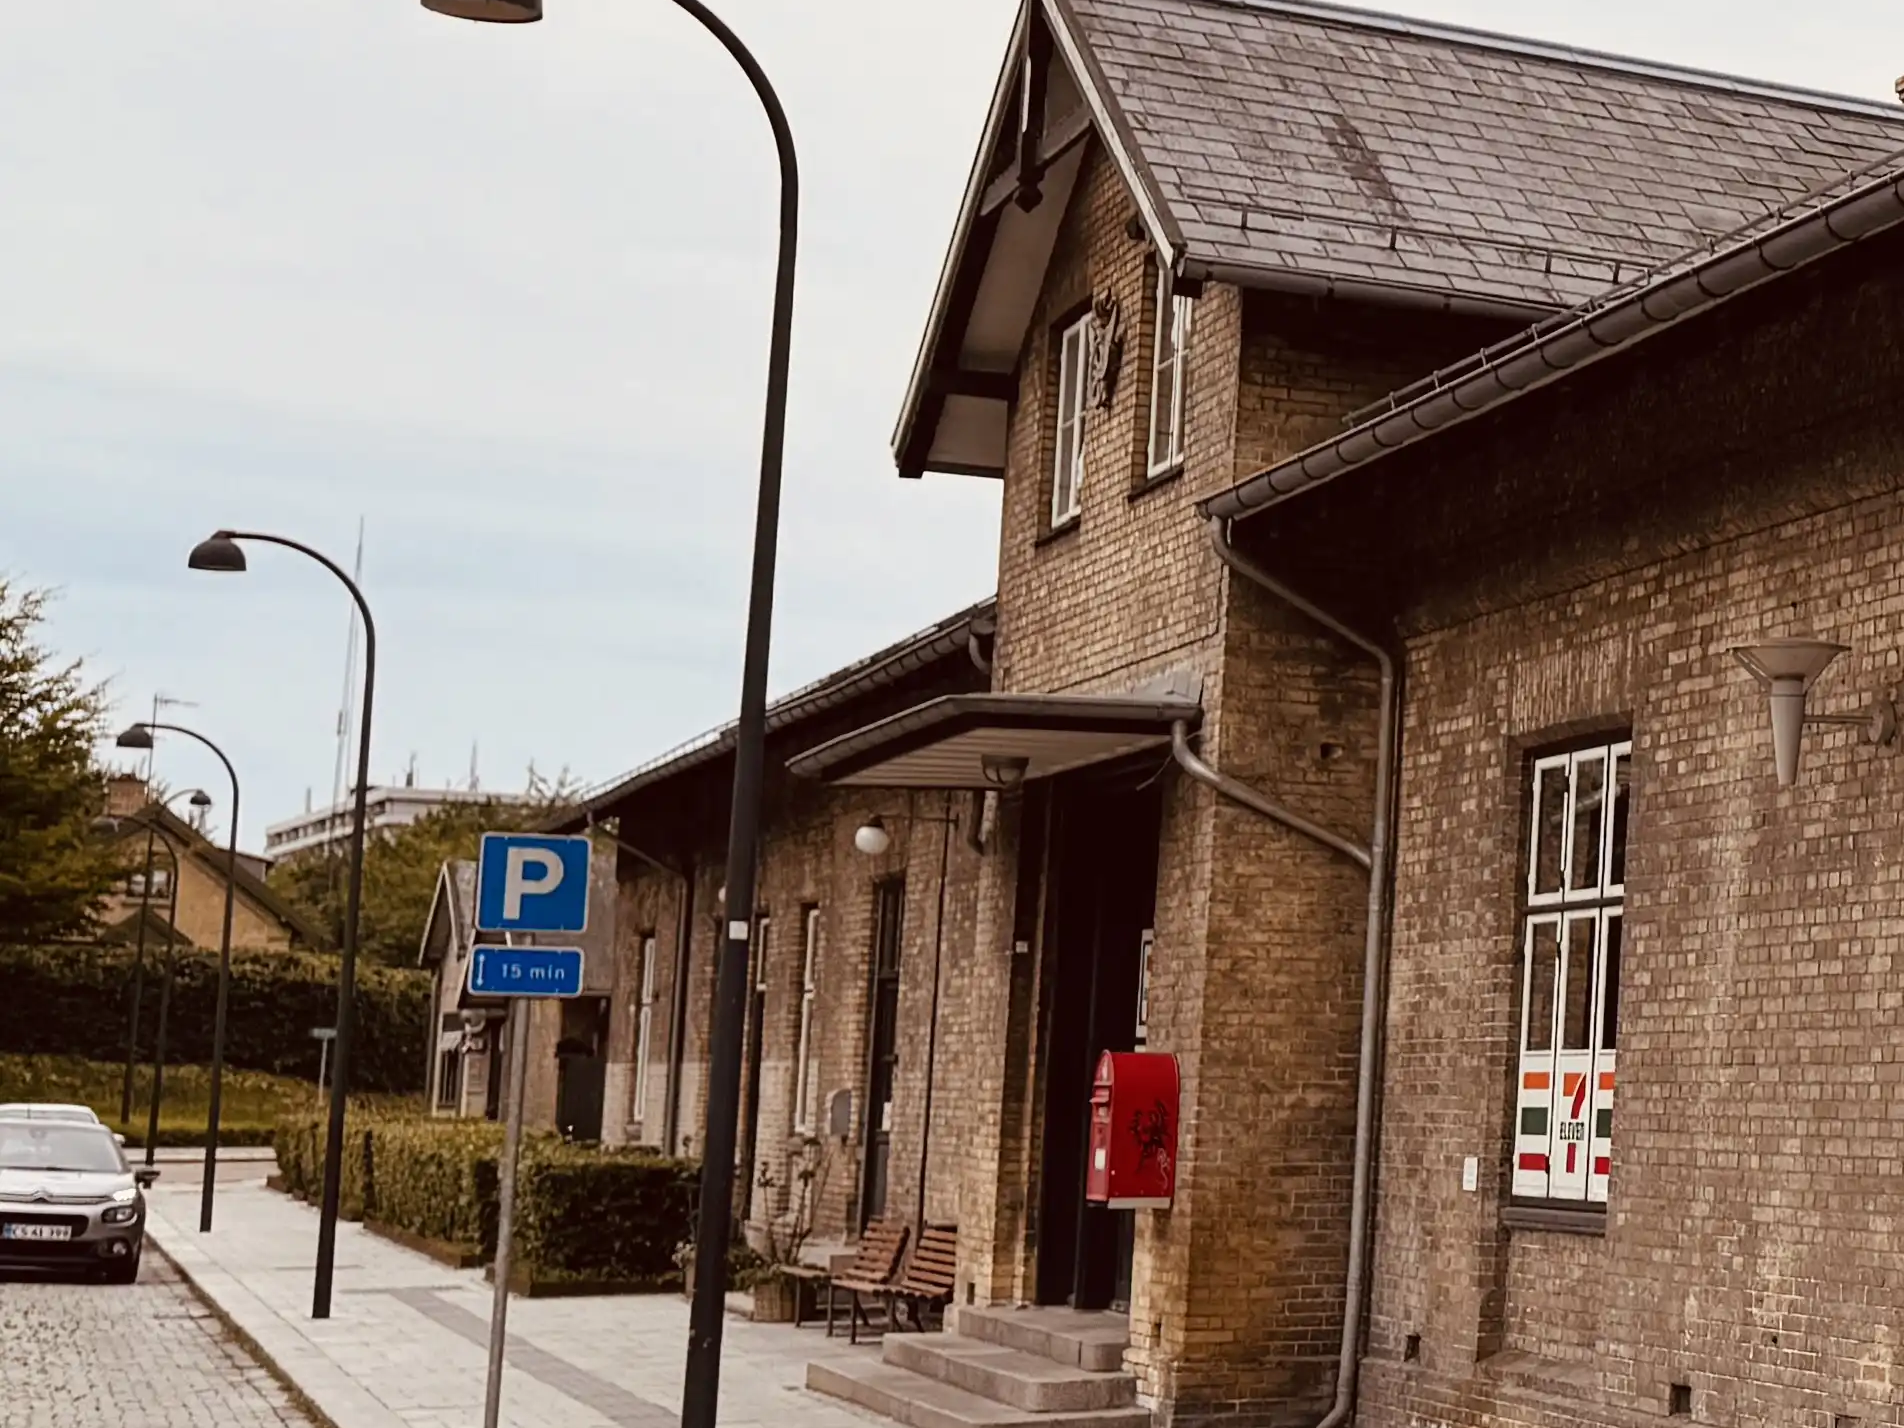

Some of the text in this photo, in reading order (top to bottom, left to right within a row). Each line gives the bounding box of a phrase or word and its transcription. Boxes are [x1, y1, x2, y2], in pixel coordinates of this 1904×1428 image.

[503, 846, 564, 921] P
[501, 963, 565, 981] 15 min
[1563, 1072, 1587, 1174] 7
